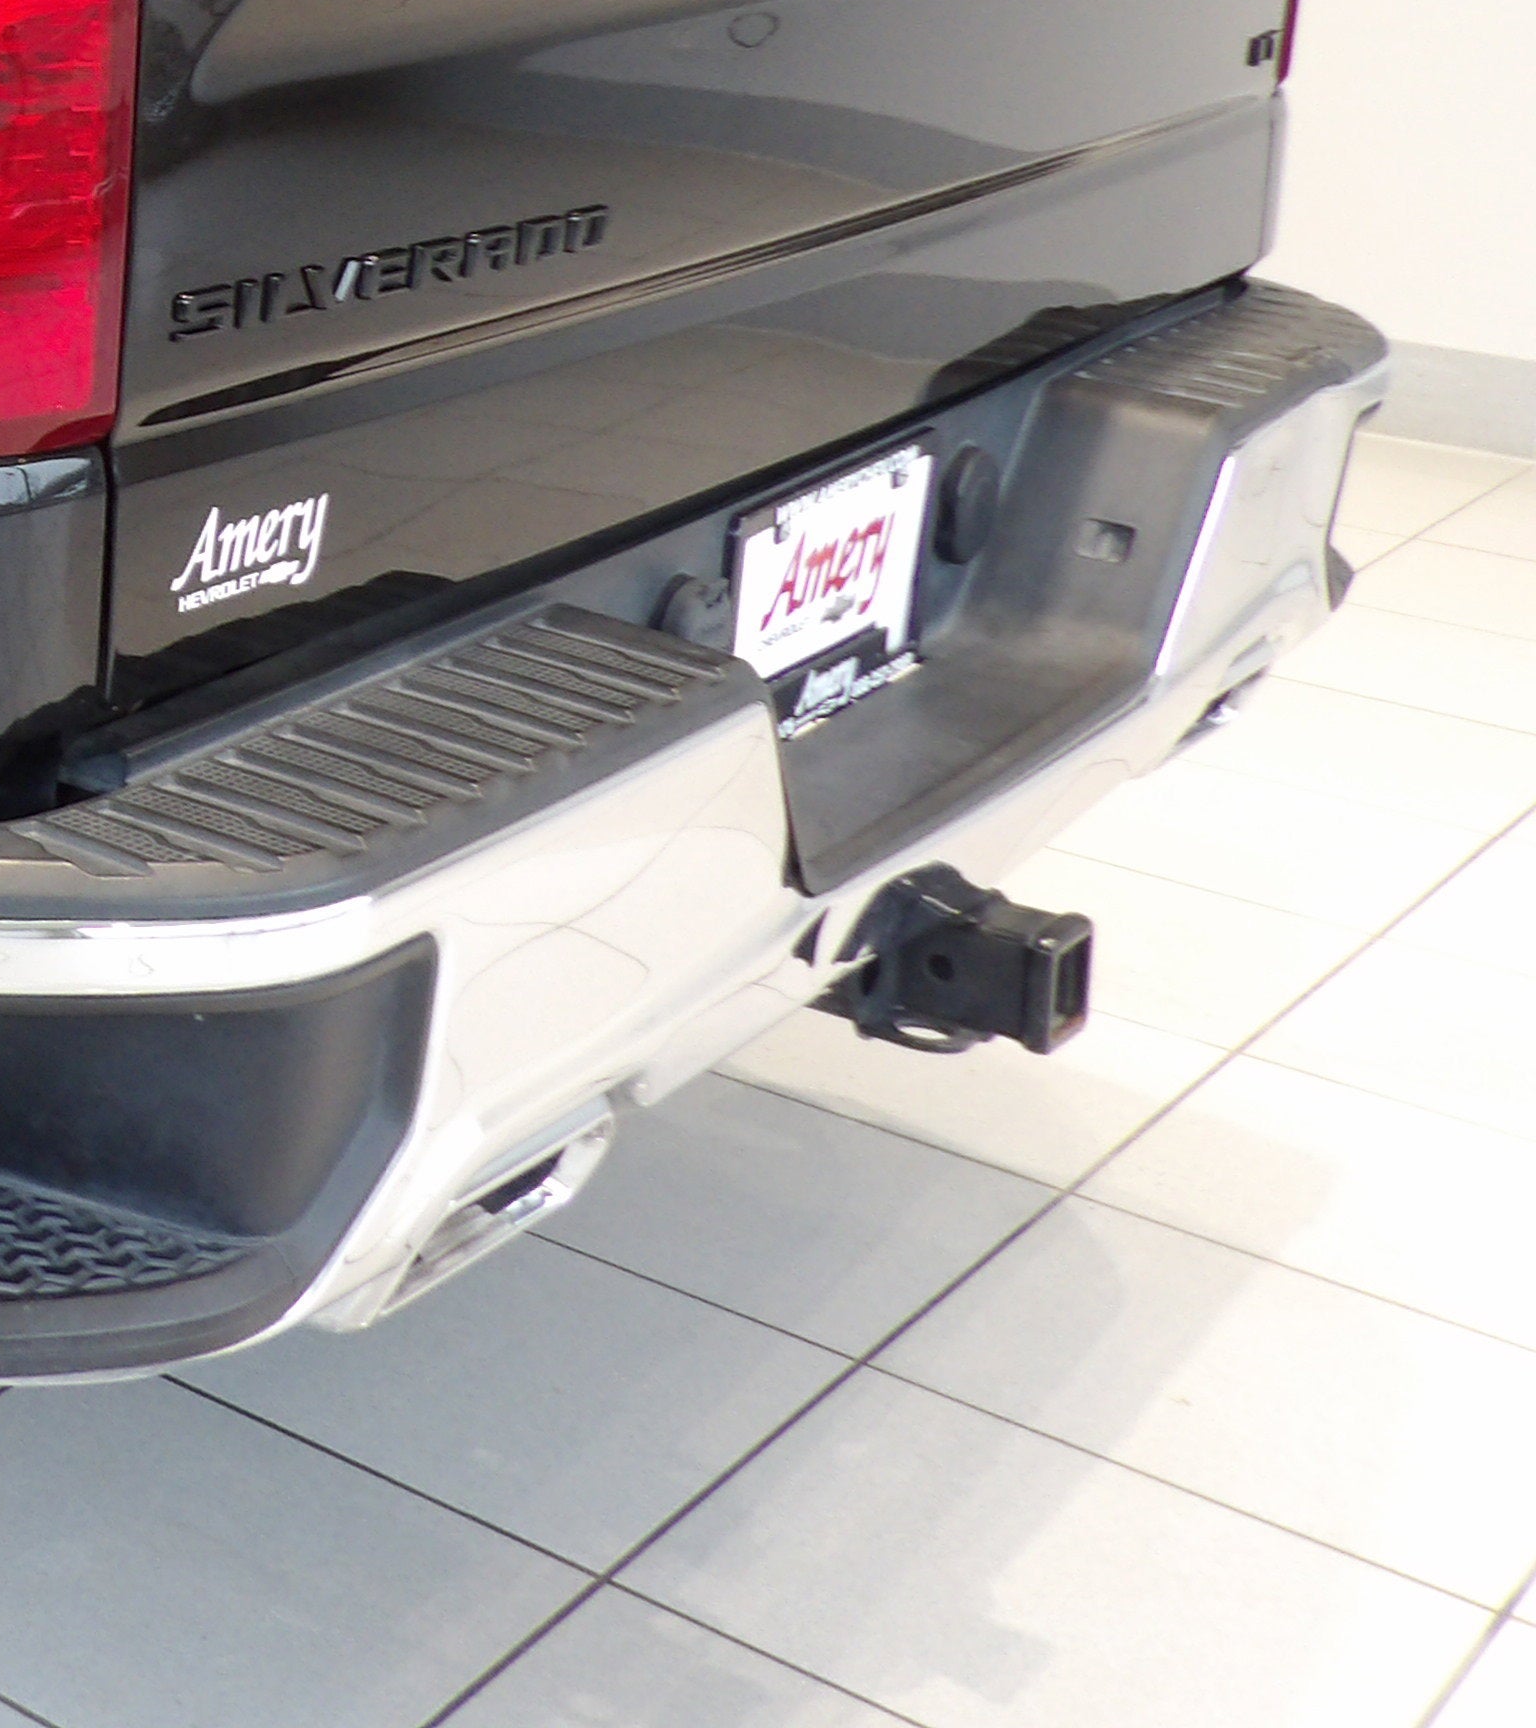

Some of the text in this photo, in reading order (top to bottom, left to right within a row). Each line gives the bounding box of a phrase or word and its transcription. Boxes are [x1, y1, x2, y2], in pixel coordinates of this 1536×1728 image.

[169, 204, 609, 342] SILVERADO
[170, 492, 329, 592] Amery
[759, 510, 896, 632] Amery
